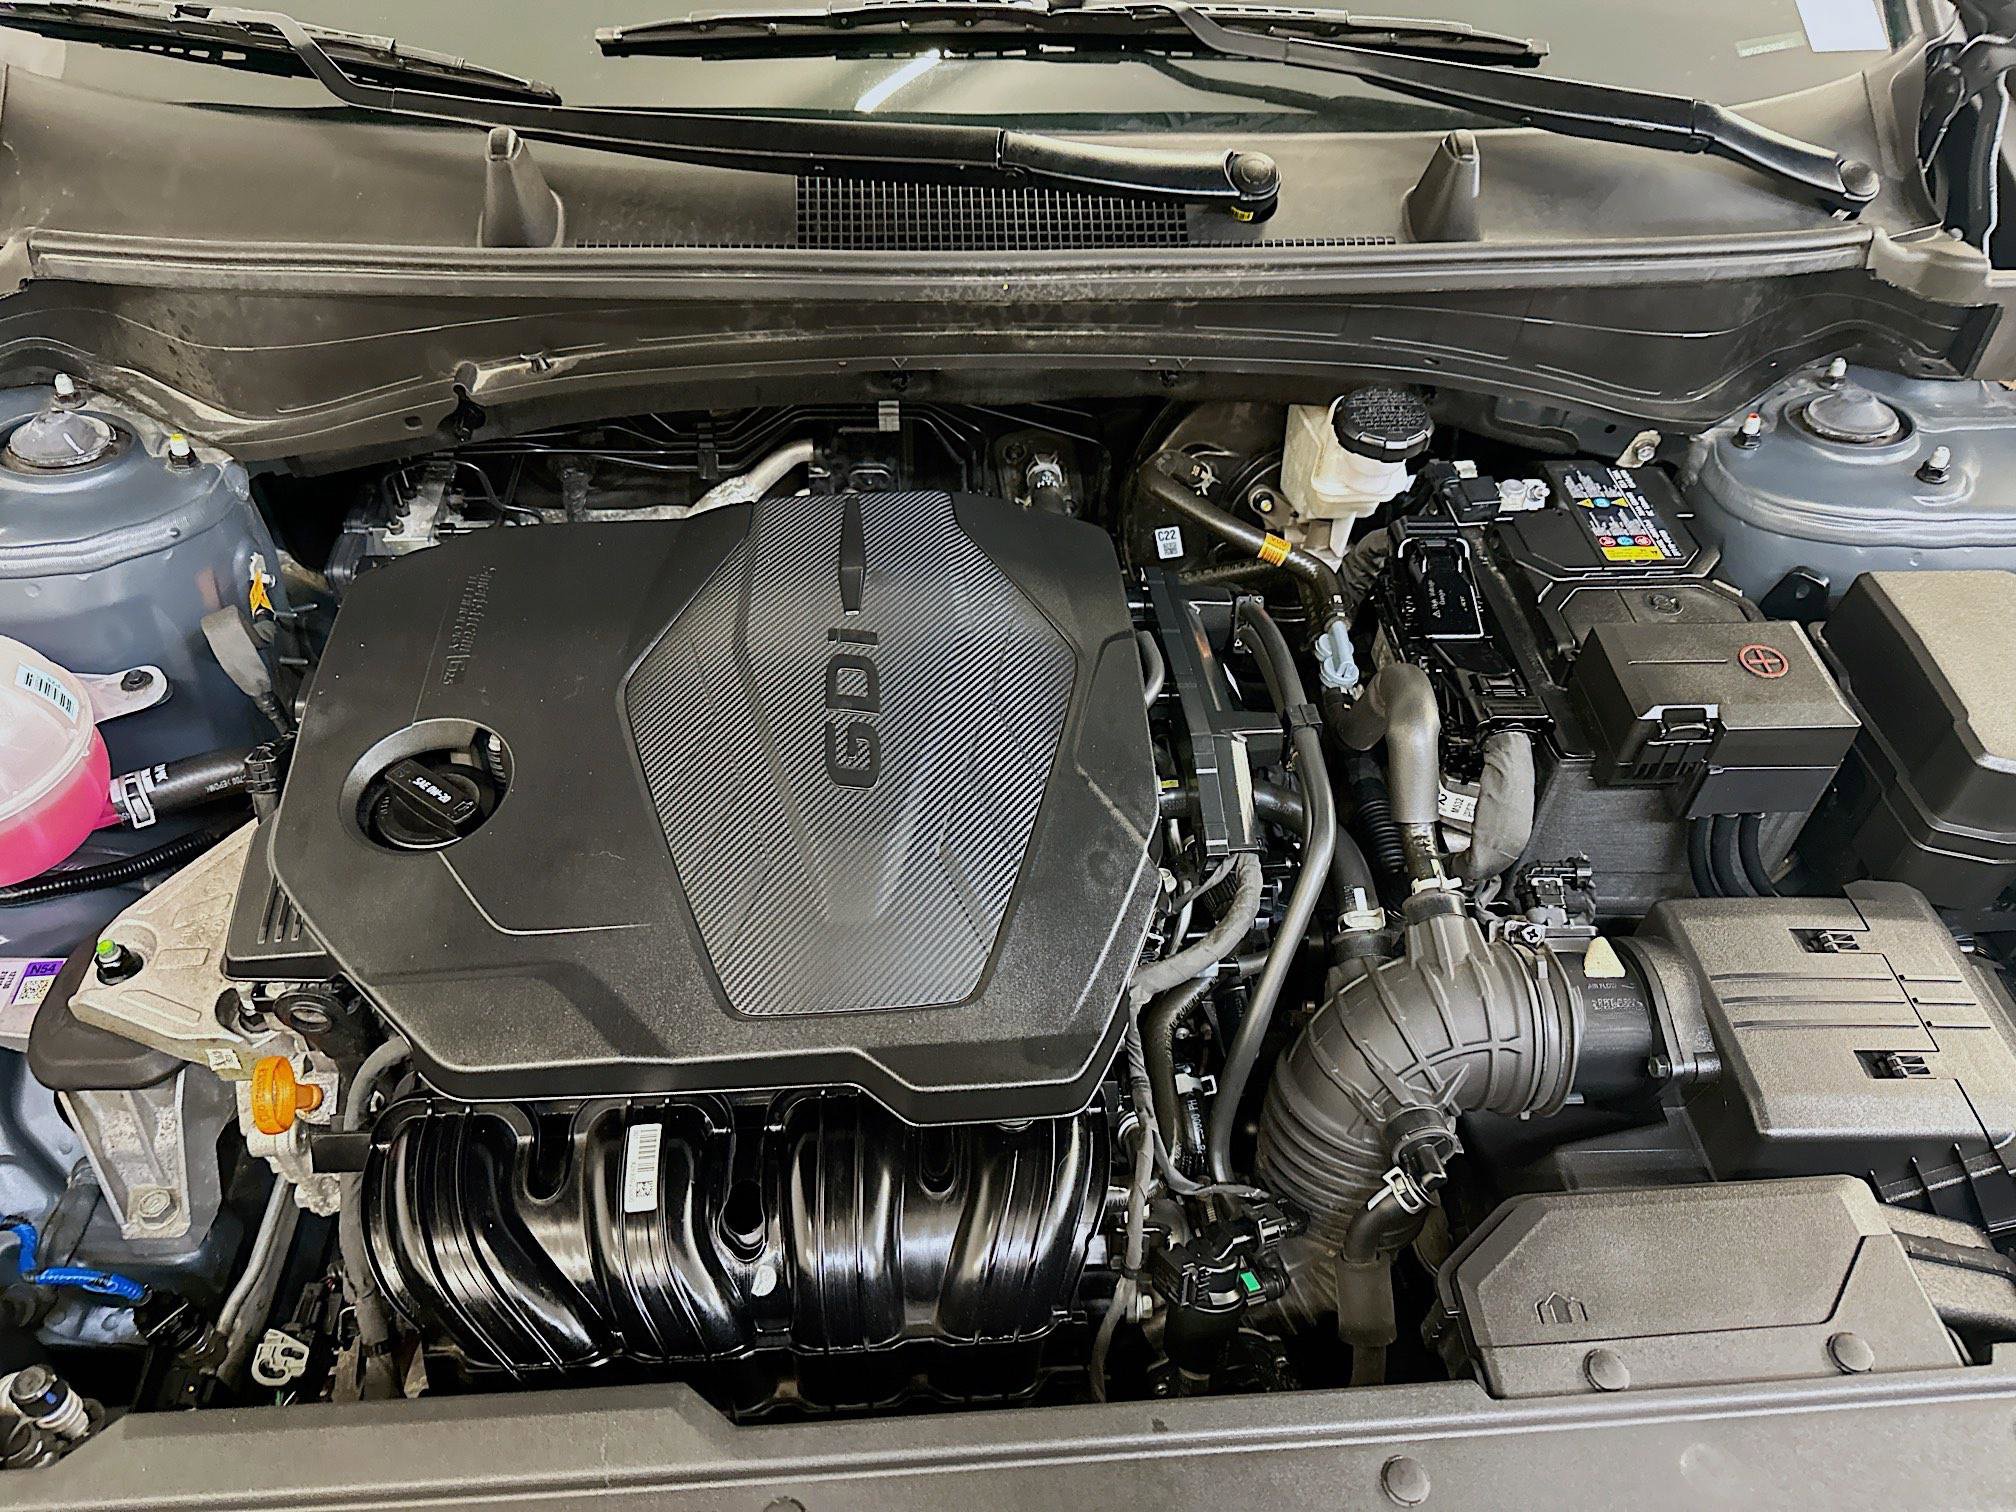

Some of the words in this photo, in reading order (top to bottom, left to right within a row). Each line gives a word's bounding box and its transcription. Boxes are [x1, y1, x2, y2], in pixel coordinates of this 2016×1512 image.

[1157, 529, 1177, 541] C22
[412, 776, 432, 790] SAE
[29, 963, 57, 975] N54
